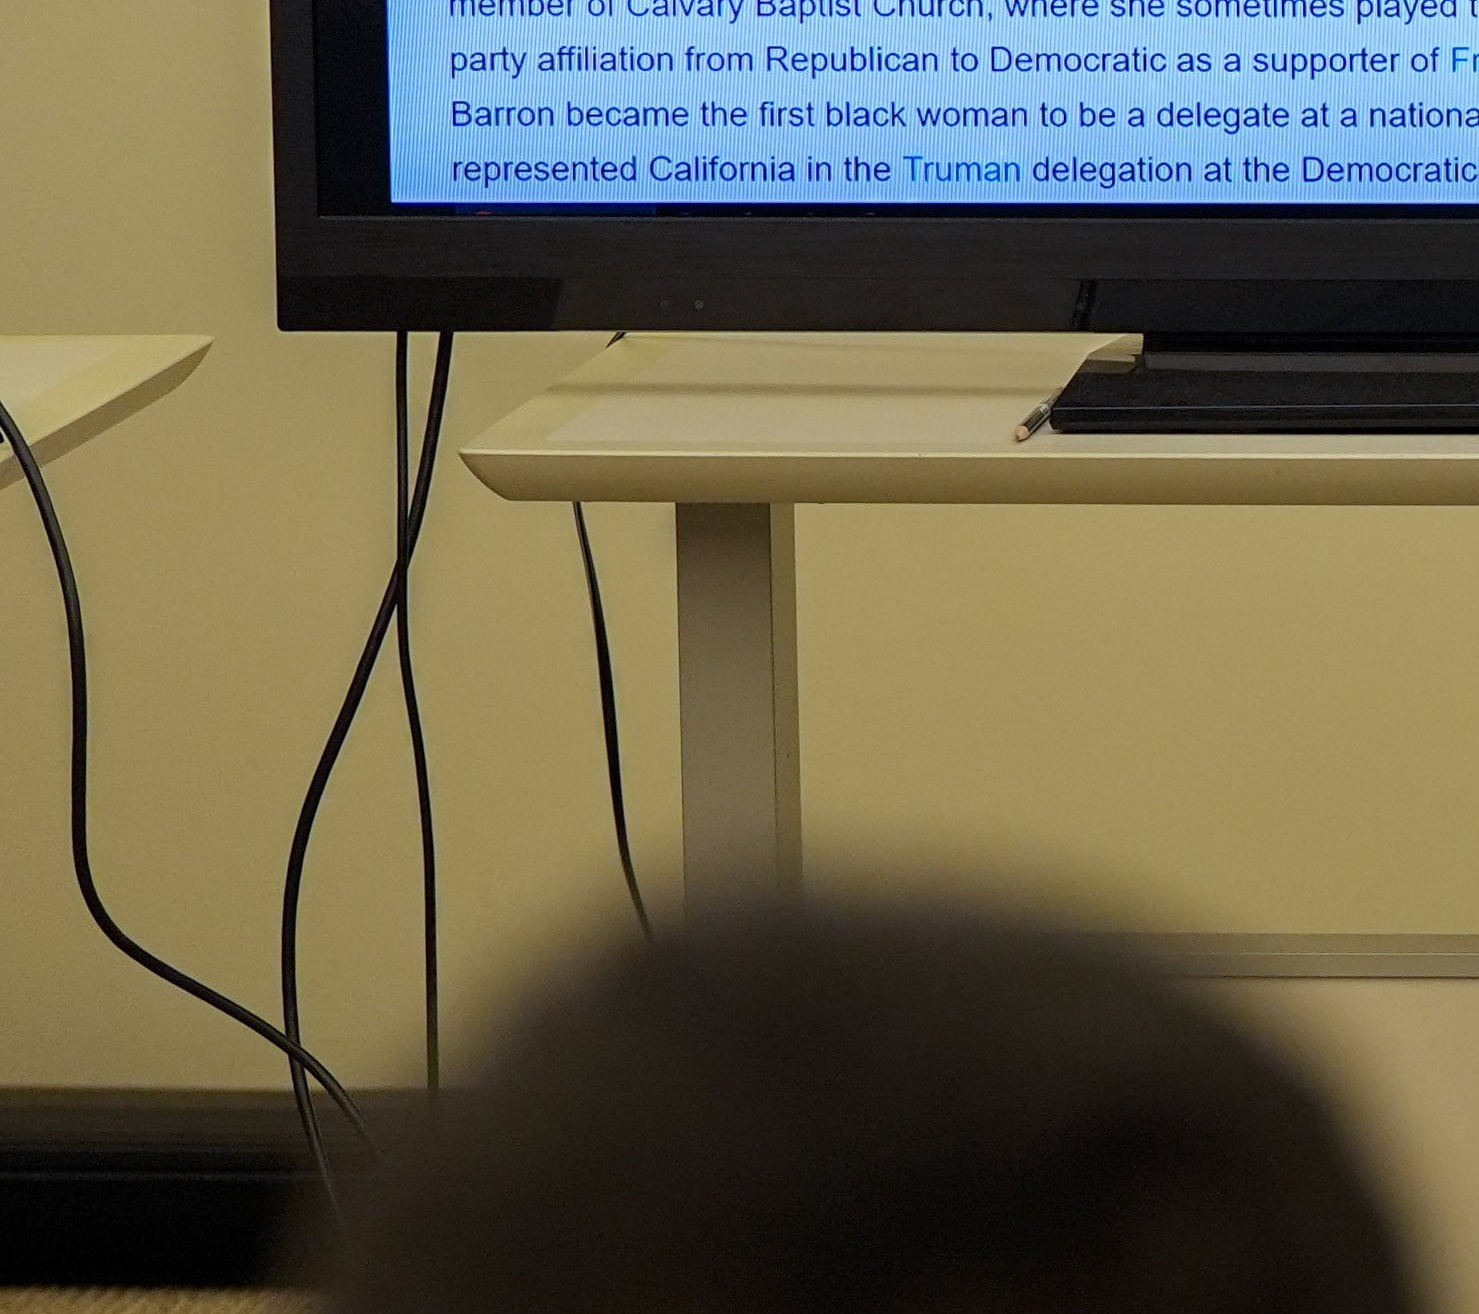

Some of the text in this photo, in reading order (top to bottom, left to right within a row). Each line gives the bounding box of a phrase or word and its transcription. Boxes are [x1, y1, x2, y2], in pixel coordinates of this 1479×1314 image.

[450, 46, 528, 80] party
[537, 45, 674, 72] affiliation
[685, 45, 754, 72] from
[766, 45, 939, 81] Republican
[950, 47, 979, 73] to
[990, 45, 1167, 73] Democratic
[1176, 52, 1213, 73] as
[1223, 52, 1242, 73] a
[1252, 47, 1401, 81] supporter
[1410, 45, 1440, 73] of
